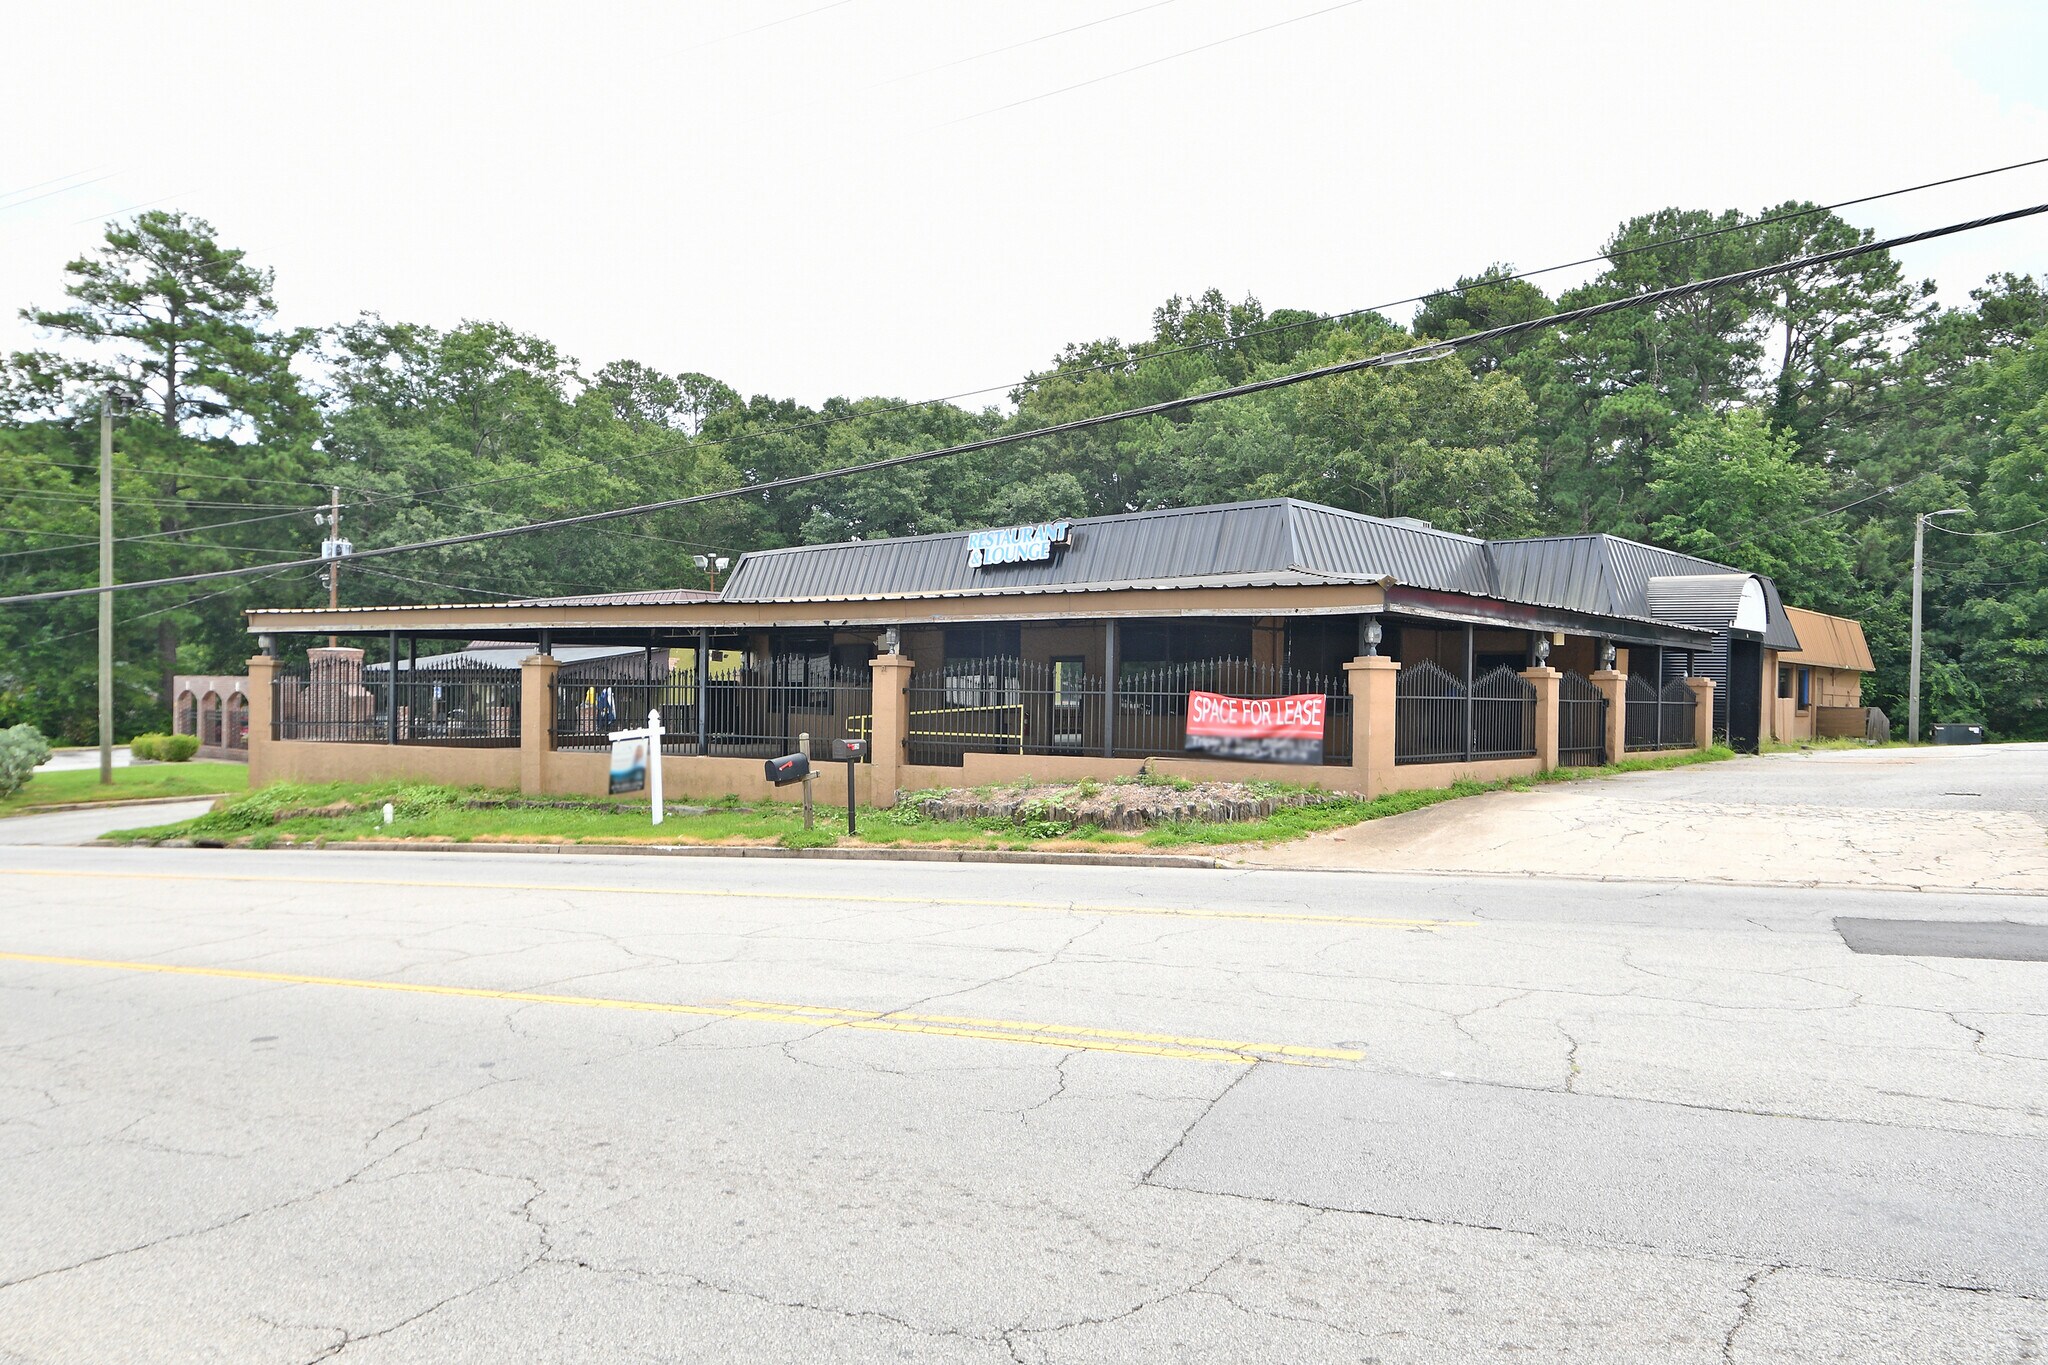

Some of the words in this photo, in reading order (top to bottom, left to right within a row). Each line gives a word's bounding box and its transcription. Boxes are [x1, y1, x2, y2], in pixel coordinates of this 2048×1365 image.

[968, 523, 1068, 549] RESTAURANT
[970, 550, 982, 566] &
[984, 541, 1049, 564] LOUNGE
[1193, 696, 1238, 724] SPACE
[1242, 700, 1272, 725] FOR
[1276, 700, 1322, 726] LEASE
